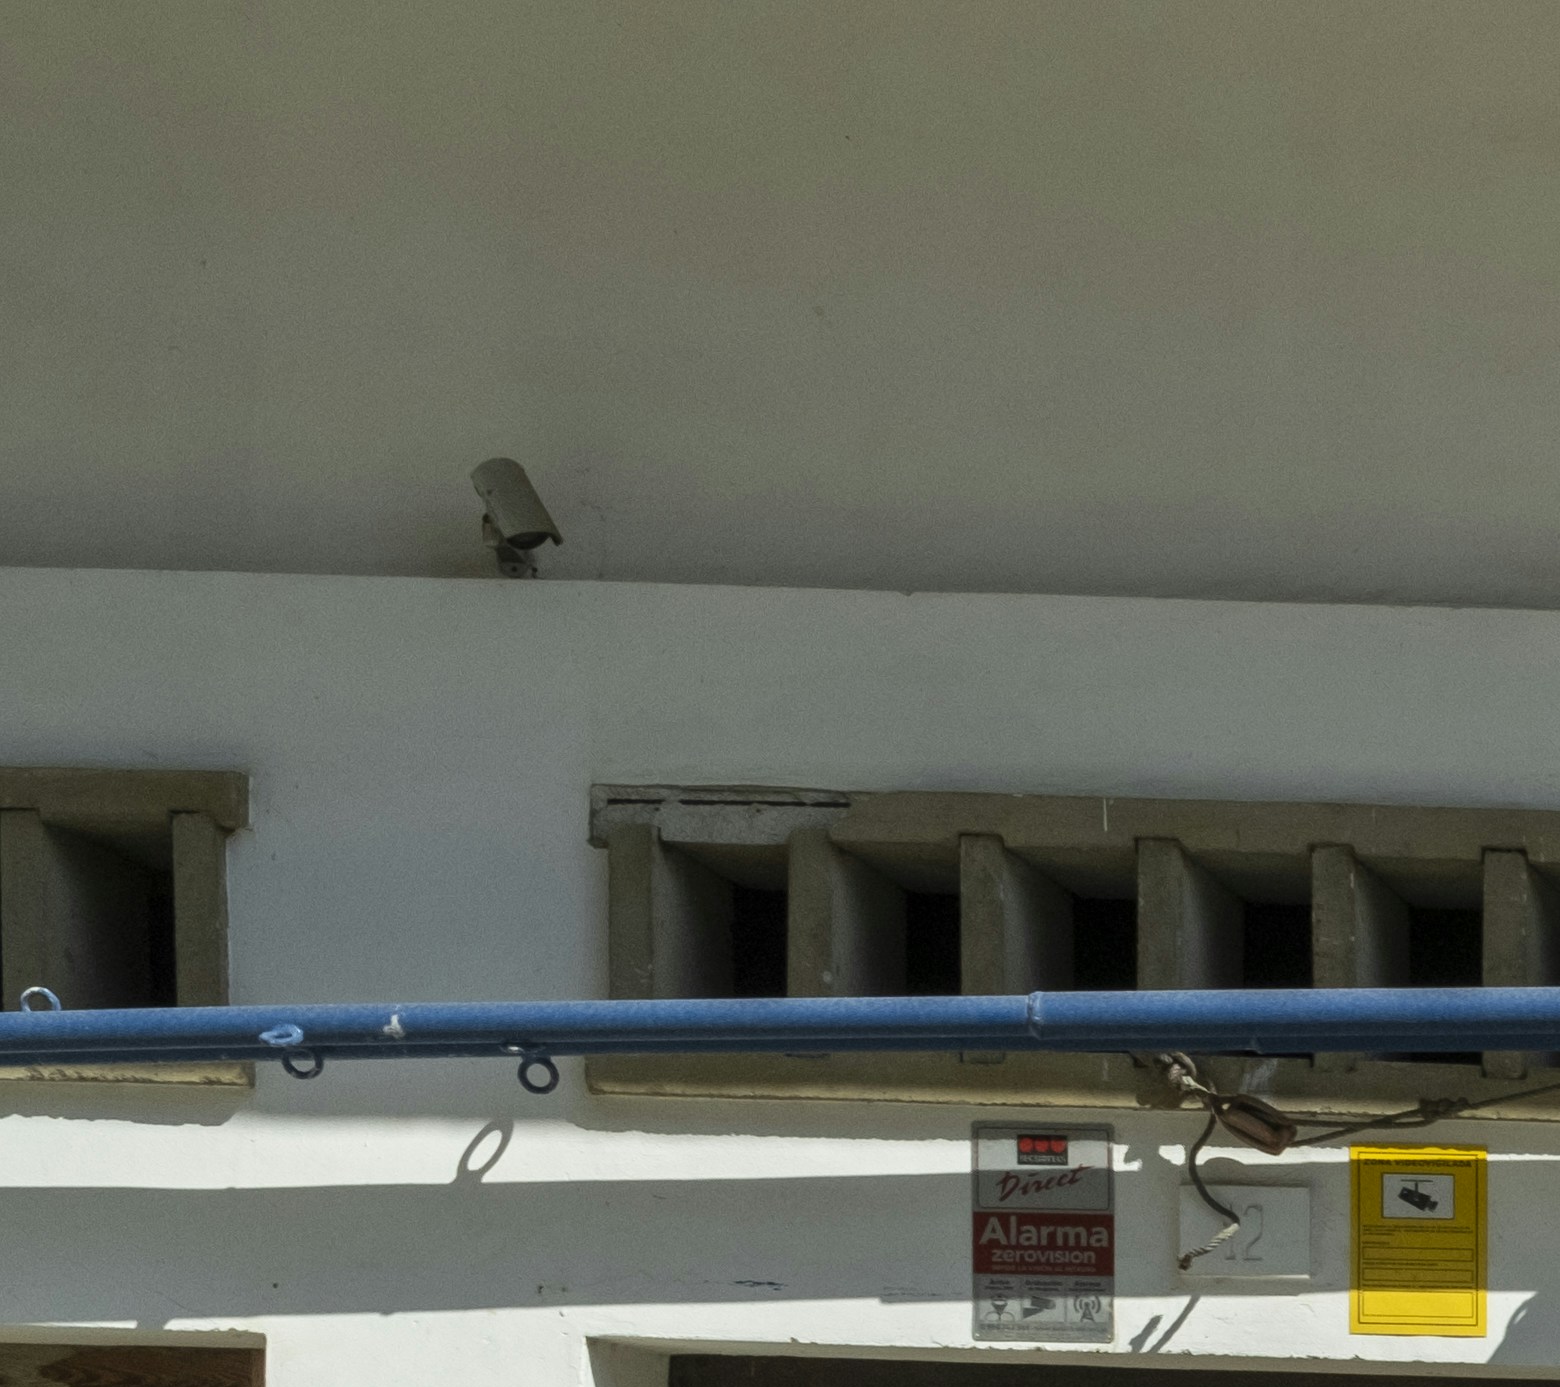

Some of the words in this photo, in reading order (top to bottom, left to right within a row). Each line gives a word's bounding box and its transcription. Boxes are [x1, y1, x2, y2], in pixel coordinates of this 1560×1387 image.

[996, 1164, 1095, 1201] Direct
[979, 1216, 1109, 1248] Alarma
[991, 1249, 1097, 1264] zerovision
